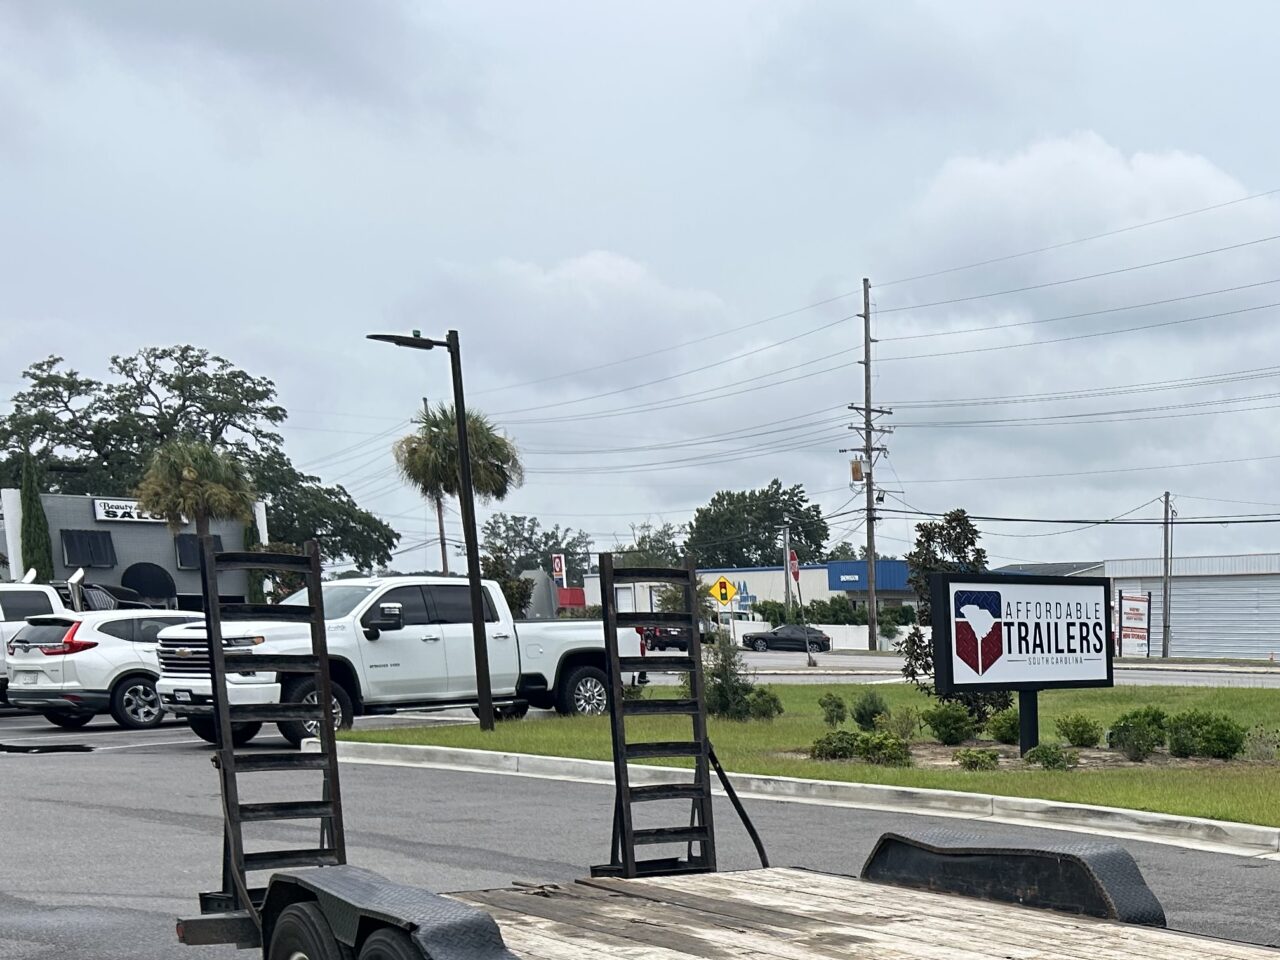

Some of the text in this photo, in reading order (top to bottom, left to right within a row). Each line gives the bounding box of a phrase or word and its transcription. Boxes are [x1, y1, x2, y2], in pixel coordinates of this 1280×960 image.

[99, 502, 133, 513] Beauty
[1005, 602, 1100, 620] AFFORDABLE
[1003, 621, 1103, 655] TRAILERS
